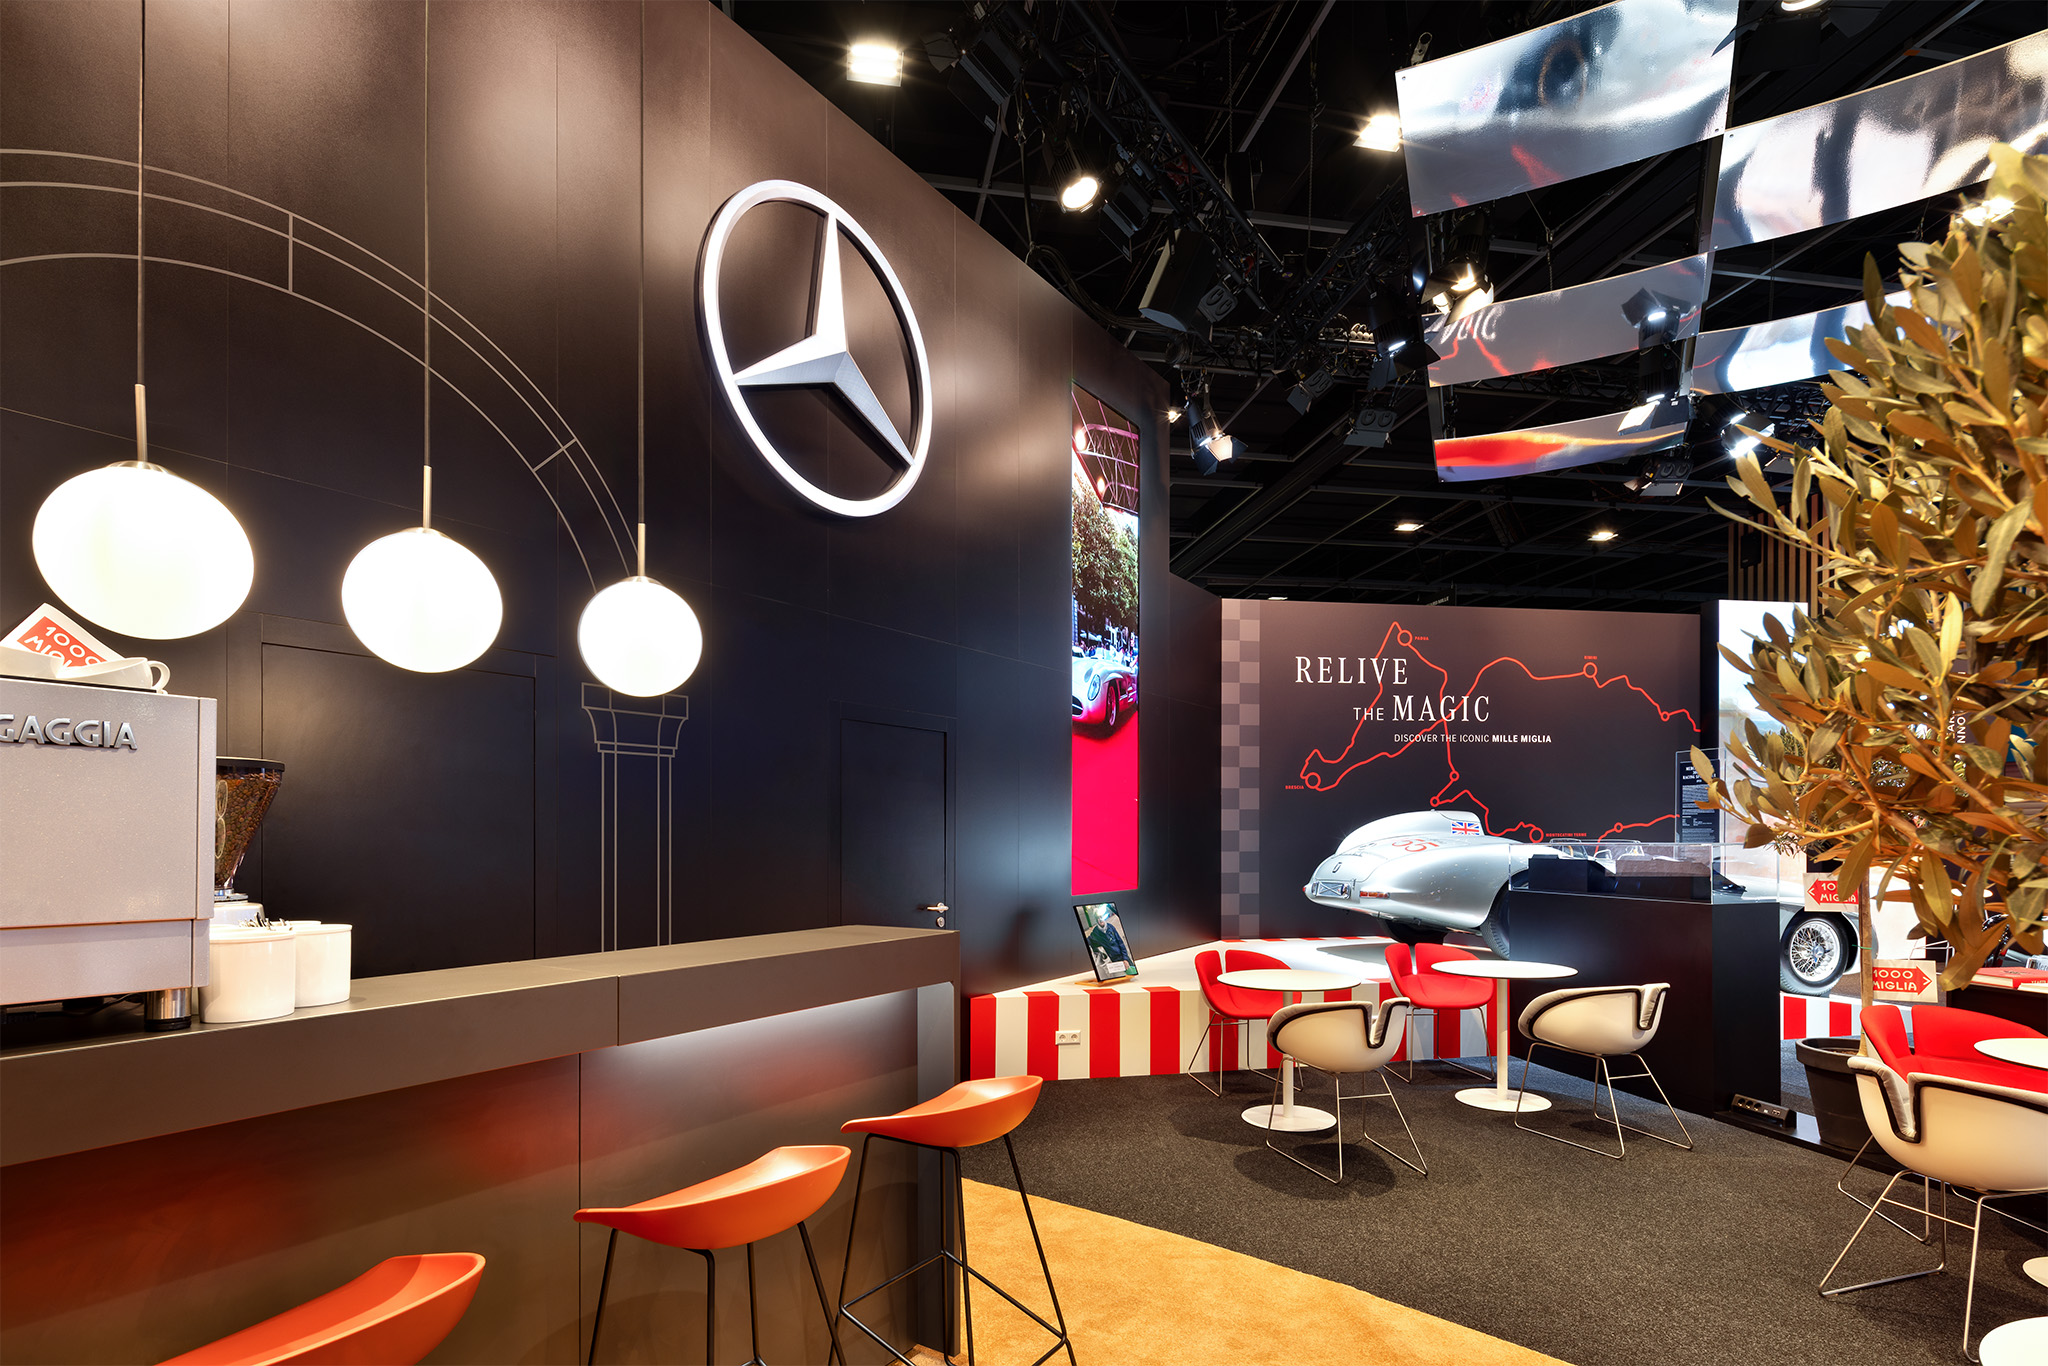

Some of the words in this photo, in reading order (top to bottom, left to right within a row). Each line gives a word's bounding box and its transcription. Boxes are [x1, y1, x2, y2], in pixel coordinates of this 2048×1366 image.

[1295, 656, 1408, 685] RELIVE
[1353, 707, 1385, 721] THE
[1392, 694, 1490, 722] MAGIC
[0, 714, 138, 751] GAGGIA
[1394, 733, 1438, 743] DISCOVER
[1441, 734, 1457, 743] THE
[1459, 734, 1490, 743] ICONIC
[1492, 734, 1518, 743] MILLE
[1520, 734, 1552, 743] MIGLIA
[1873, 969, 1914, 979] 1000
[1873, 981, 1918, 991] MIGLIA
